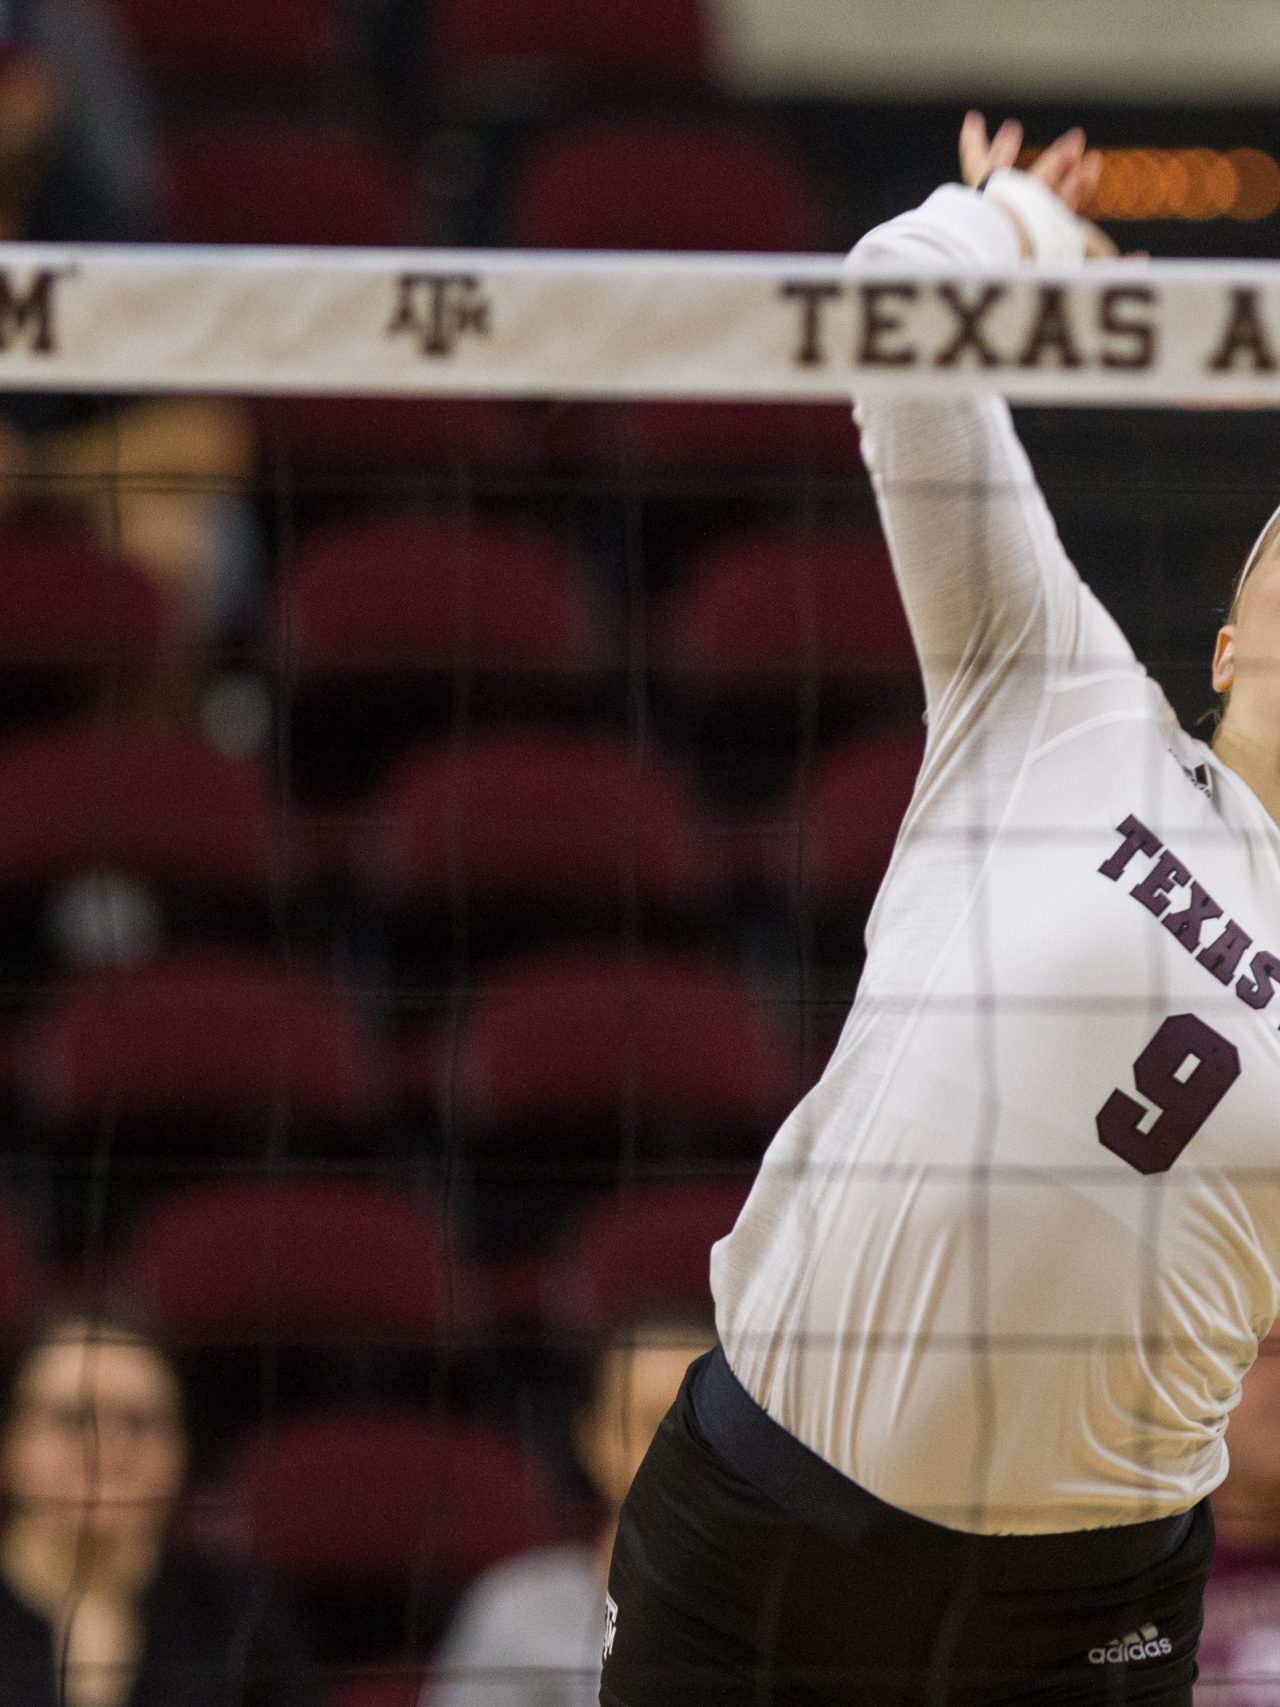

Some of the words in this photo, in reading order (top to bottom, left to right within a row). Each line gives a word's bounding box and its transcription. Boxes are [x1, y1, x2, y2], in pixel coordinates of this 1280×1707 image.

[781, 280, 1158, 371] TEXAS
[1095, 1013, 1241, 1175] 9
[1088, 1637, 1172, 1664] adidas
